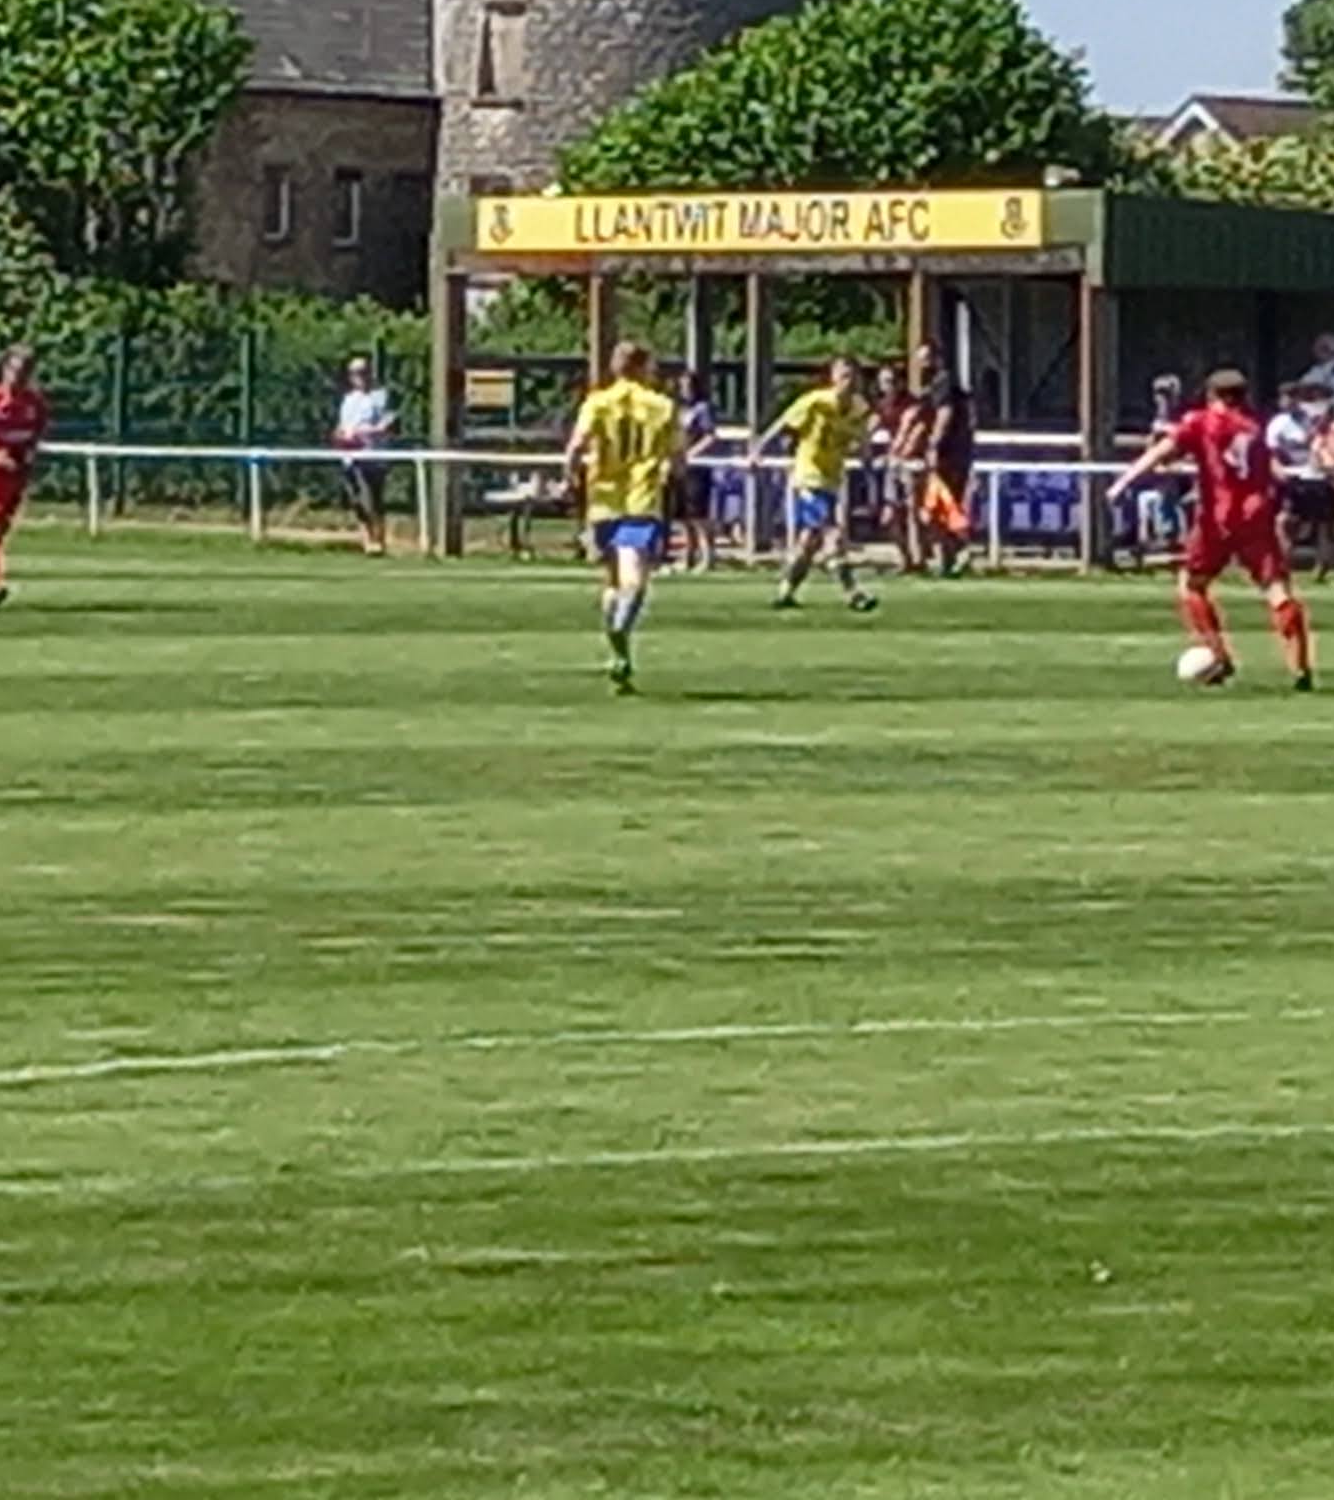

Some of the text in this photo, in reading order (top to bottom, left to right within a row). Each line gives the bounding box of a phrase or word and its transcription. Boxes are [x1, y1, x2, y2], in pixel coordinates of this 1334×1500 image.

[574, 198, 931, 242] LLANTWIT MAJOR AFC
